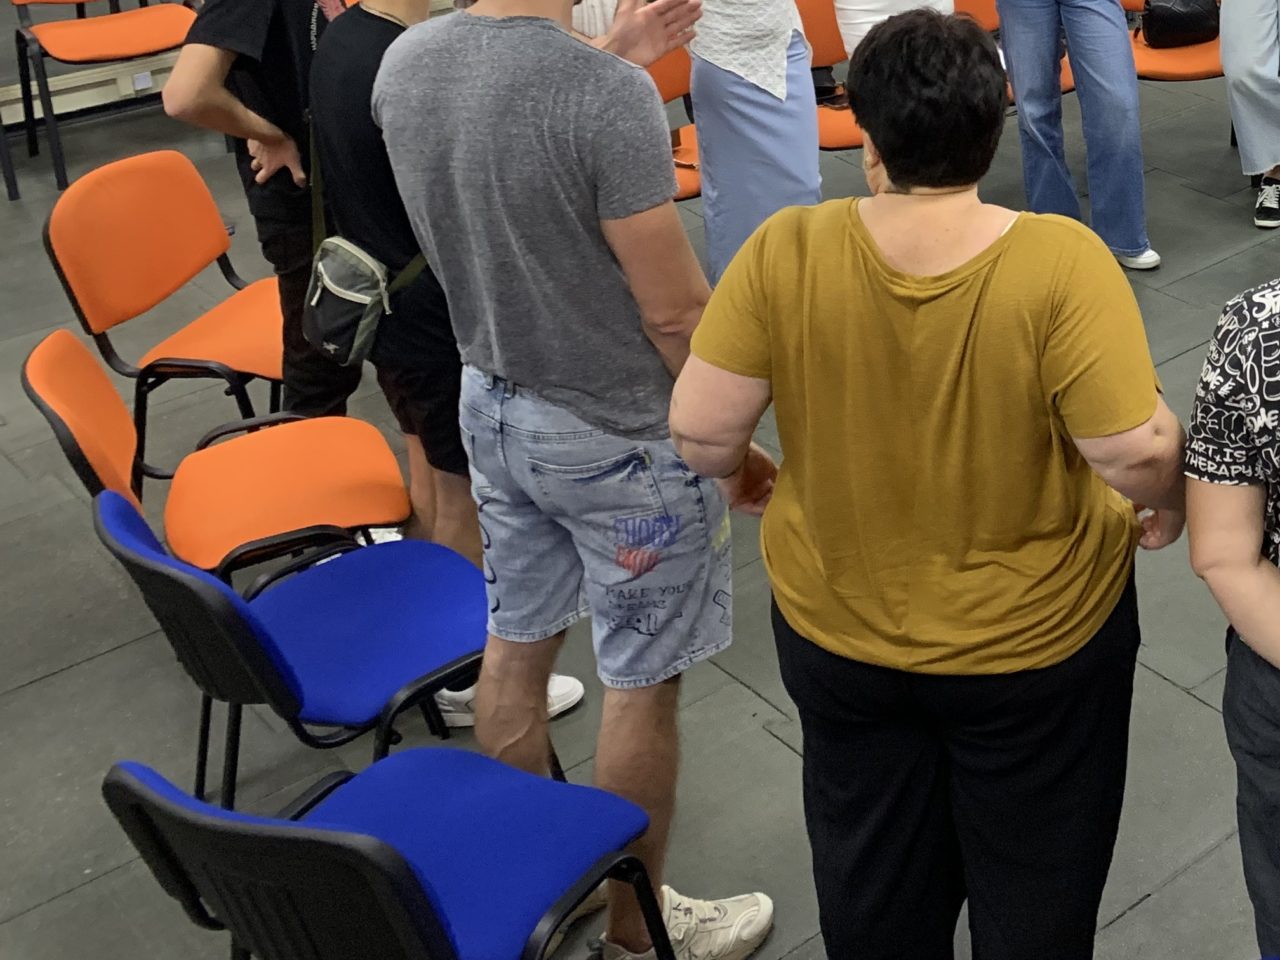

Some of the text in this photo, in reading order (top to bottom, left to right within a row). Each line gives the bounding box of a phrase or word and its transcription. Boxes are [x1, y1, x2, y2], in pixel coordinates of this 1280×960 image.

[1185, 450, 1254, 478] THERAPY
[1190, 440, 1247, 463] ART IS
